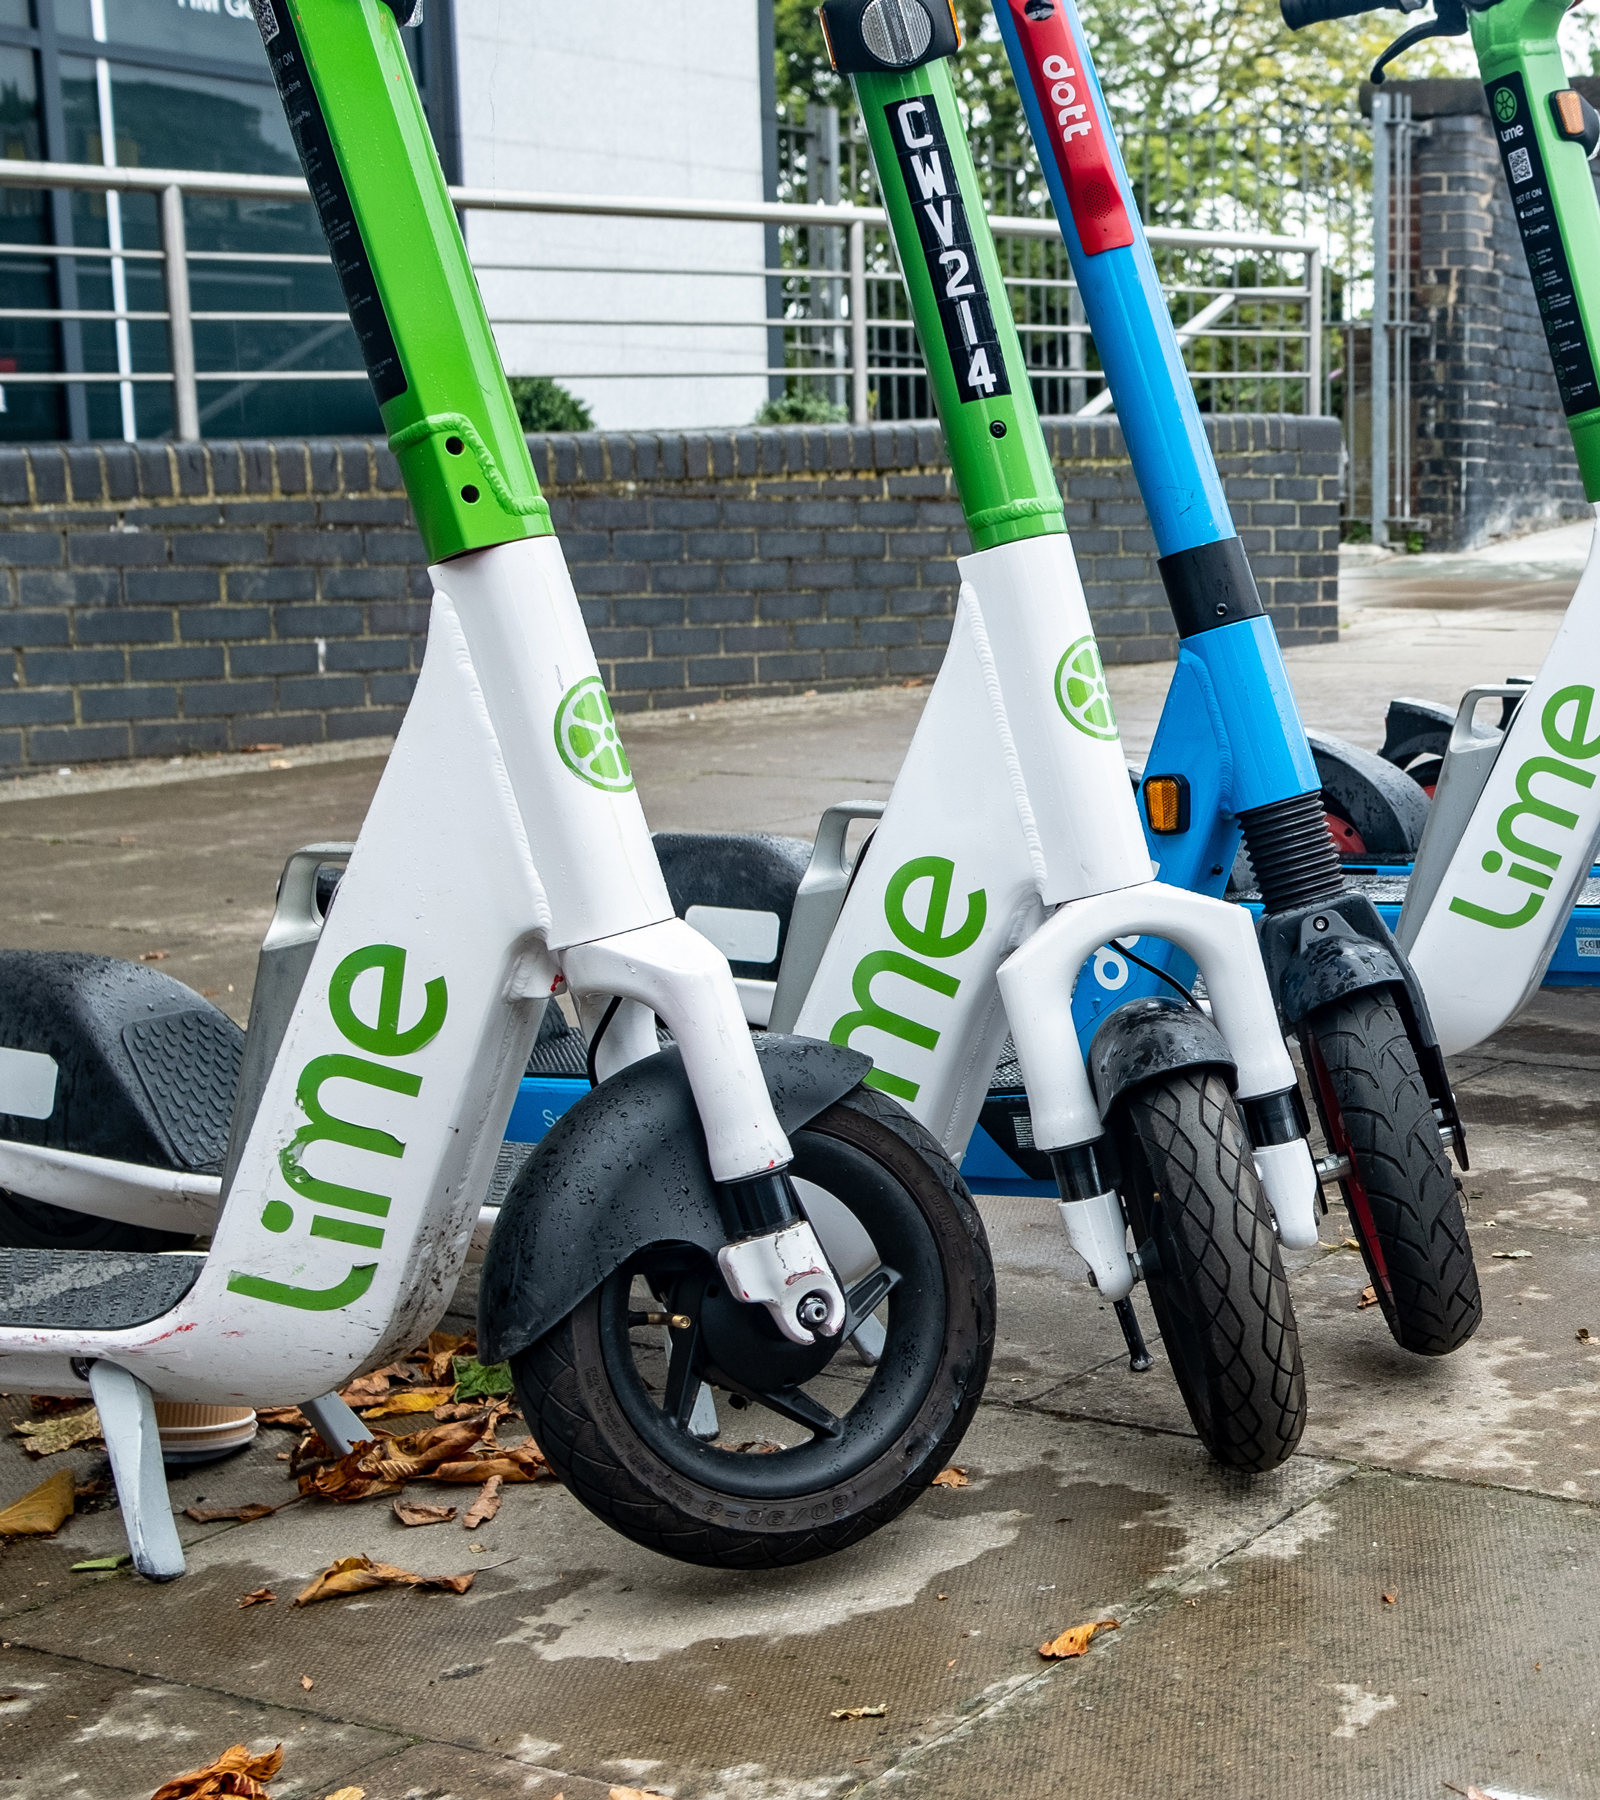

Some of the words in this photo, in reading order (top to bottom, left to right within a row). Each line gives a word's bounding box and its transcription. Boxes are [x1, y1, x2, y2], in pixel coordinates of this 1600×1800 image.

[1042, 54, 1089, 144] dott
[1515, 192, 1526, 205] GET
[1531, 188, 1542, 199] ON
[897, 101, 997, 394] CWV214
[829, 855, 988, 1103] me
[226, 944, 449, 1312] Lime
